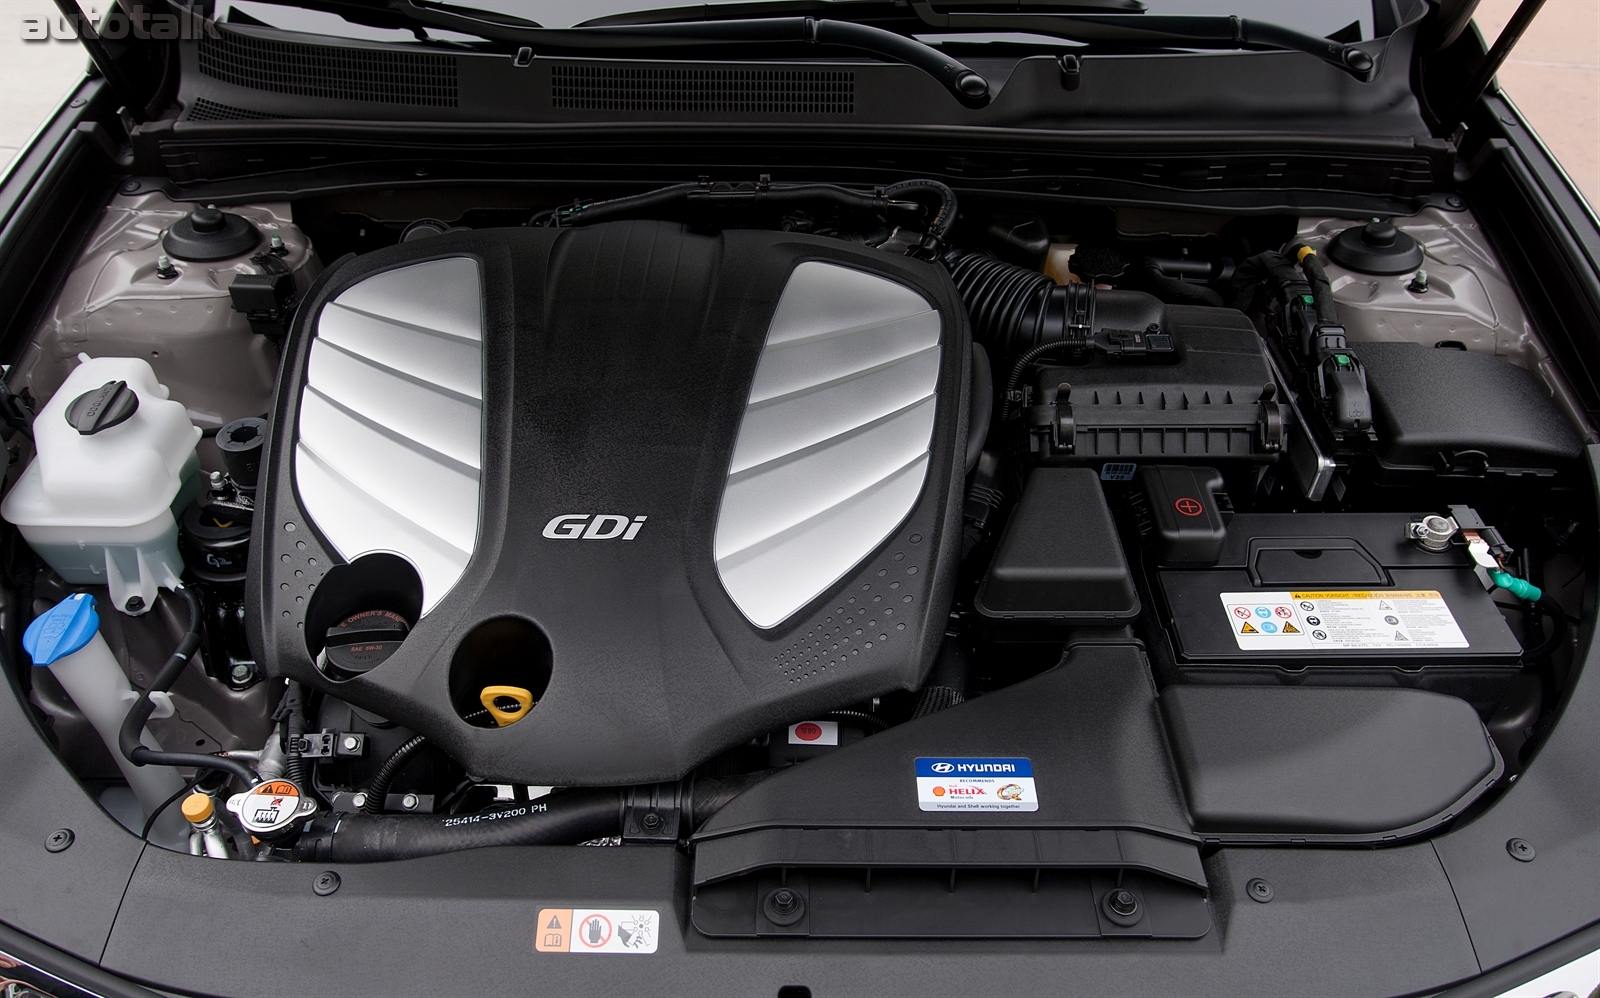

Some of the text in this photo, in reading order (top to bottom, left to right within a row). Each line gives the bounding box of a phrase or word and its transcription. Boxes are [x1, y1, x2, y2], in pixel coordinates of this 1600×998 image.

[542, 514, 648, 540] GDi
[348, 610, 383, 623] OWNER'S
[957, 763, 1016, 773] HYUNDAI
[948, 787, 986, 795] HELIX
[444, 803, 547, 827] 25414-3V200 PH
